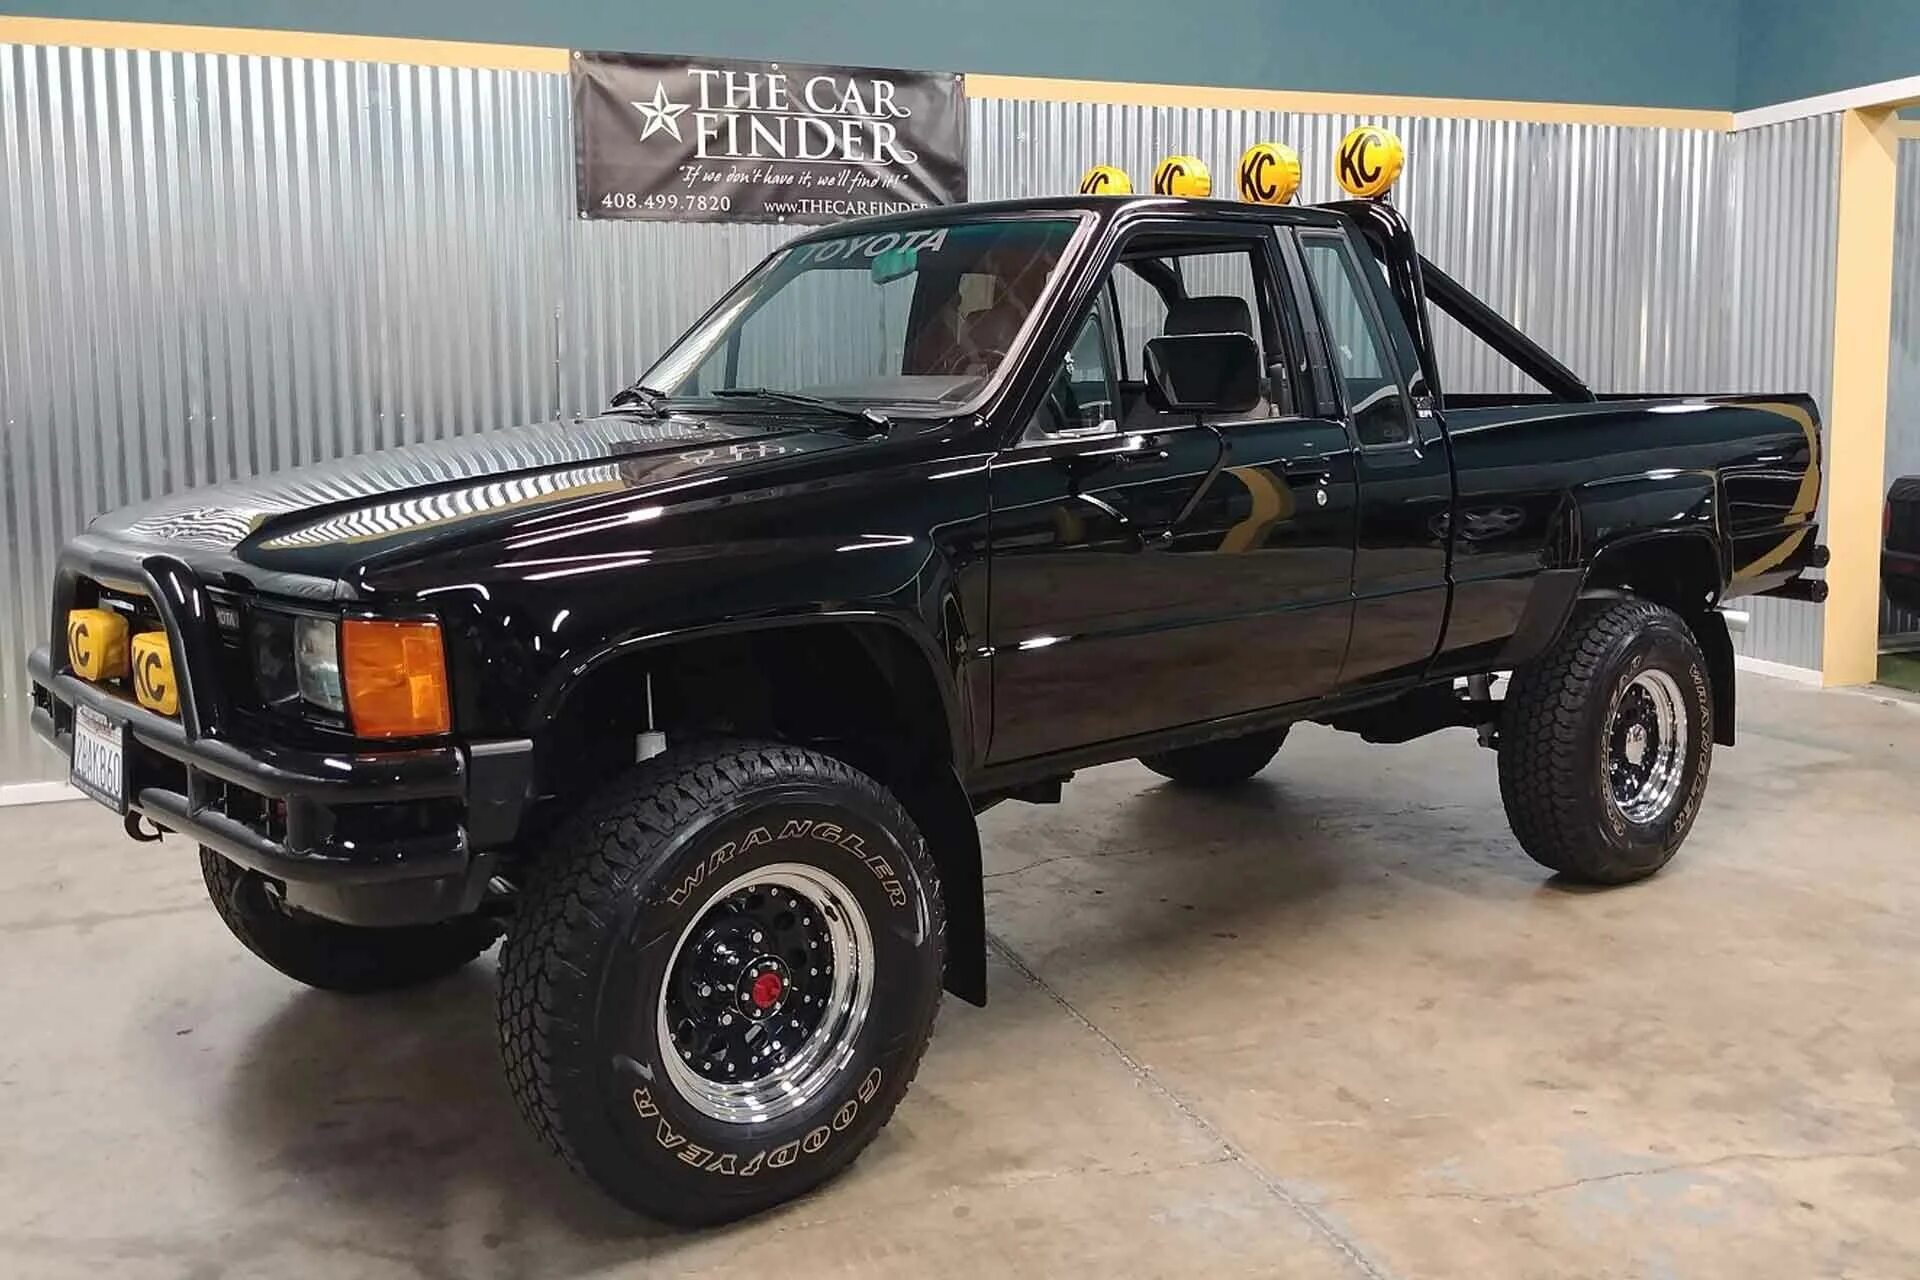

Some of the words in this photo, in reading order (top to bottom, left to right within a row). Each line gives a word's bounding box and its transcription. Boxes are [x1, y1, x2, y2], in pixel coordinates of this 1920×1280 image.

[688, 69, 790, 112] THE
[804, 77, 911, 119] CAR
[693, 112, 918, 164] FINDER
[1341, 132, 1382, 188] KC
[702, 171, 722, 182] we
[726, 165, 762, 183] don't
[763, 164, 795, 185] have
[798, 171, 812, 188] it,
[817, 169, 851, 186] we'll
[847, 169, 880, 194] find
[1154, 163, 1185, 195] KC
[1241, 152, 1276, 199] KC
[601, 192, 731, 212] 408.499.7820
[796, 227, 949, 265] TOYOTA
[668, 819, 908, 908] WRANGLER
[632, 1066, 882, 1177] GOODYEAR
